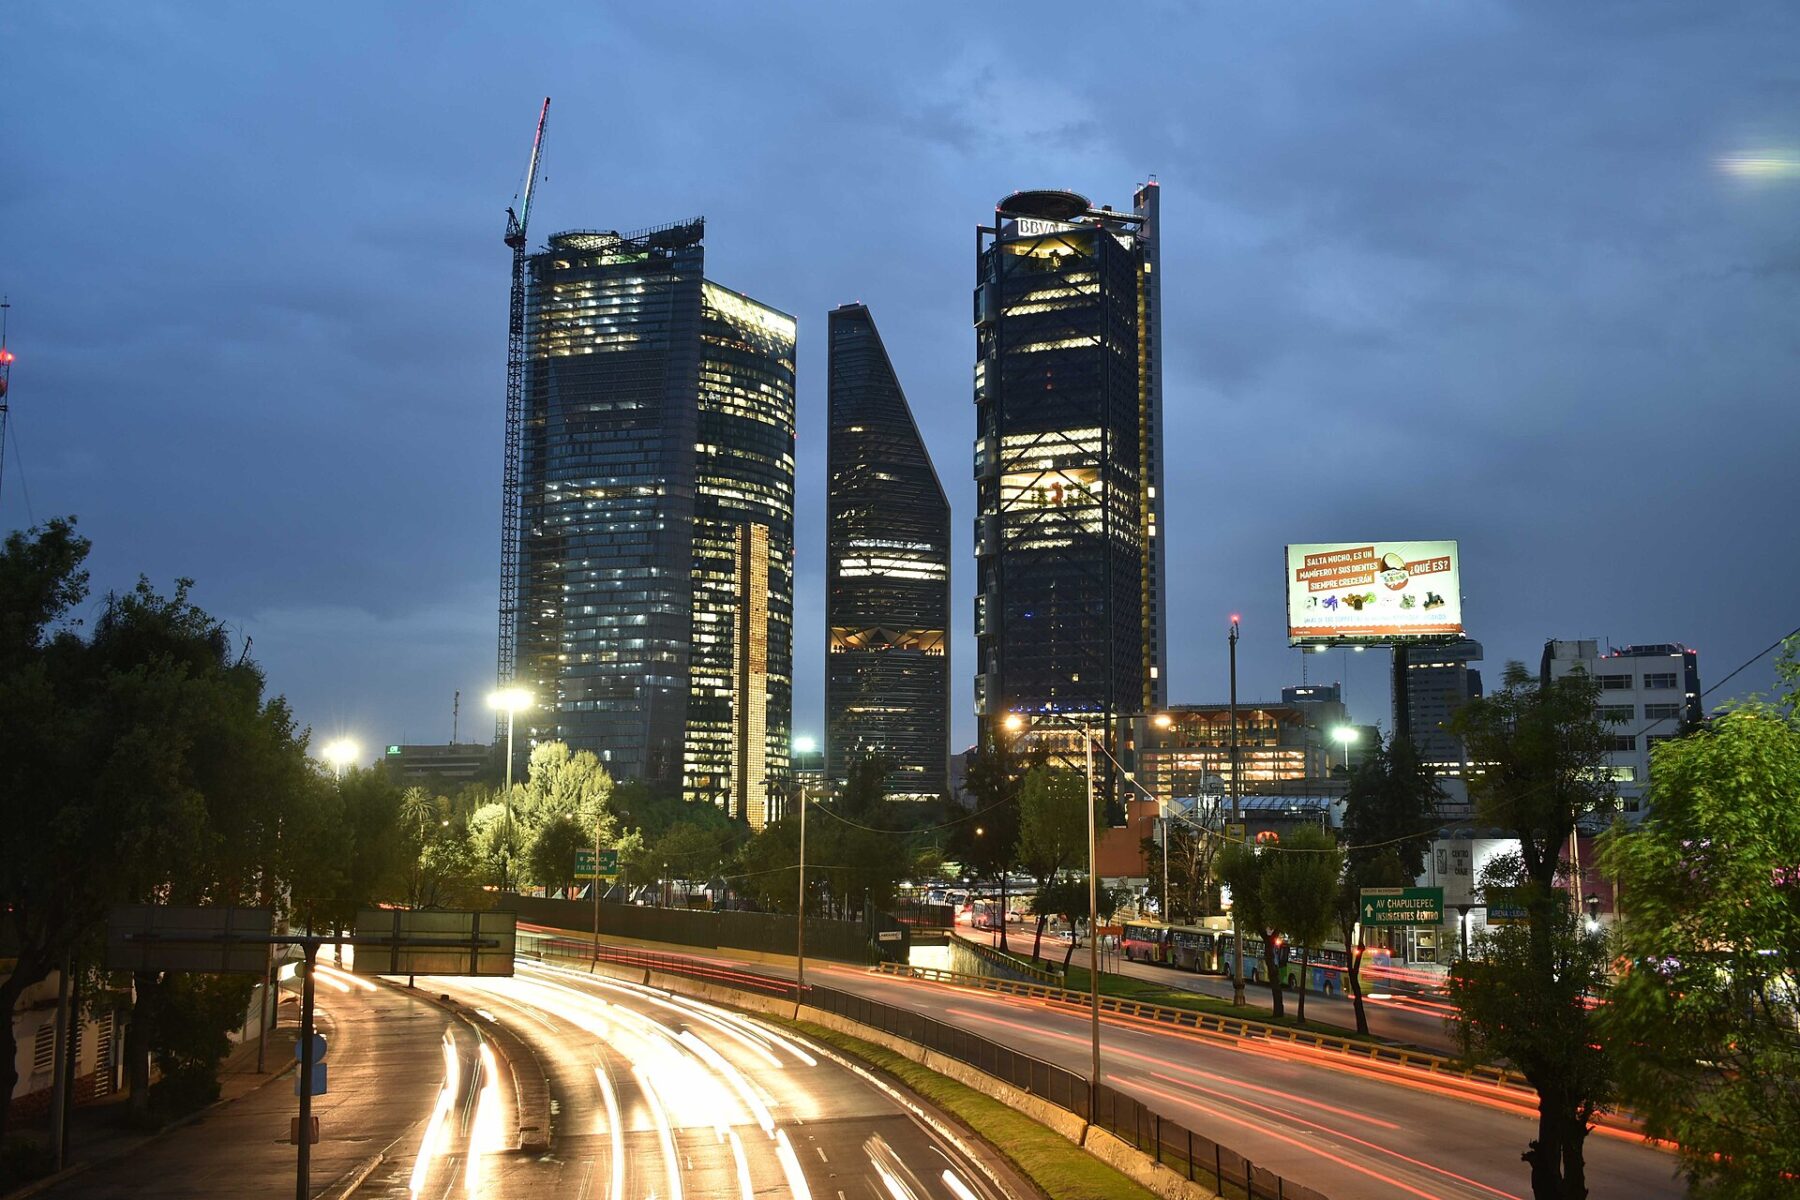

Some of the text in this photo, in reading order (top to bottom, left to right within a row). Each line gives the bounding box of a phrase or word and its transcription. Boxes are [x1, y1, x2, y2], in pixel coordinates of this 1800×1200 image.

[1020, 219, 1056, 234] BBVA
[1307, 550, 1373, 567] SALTA MUCHO, ES UN
[1300, 568, 1332, 579] MAMÍFERO
[1332, 567, 1338, 575] Y
[1338, 566, 1351, 575] SUS
[1410, 560, 1448, 575] ¿QUÉ ES?
[1310, 573, 1373, 591] SIEMPRE CRECERÁN
[1376, 898, 1434, 908] AV CHAPULTEPEC
[1375, 910, 1439, 921] INSURGENTES CENTRO
